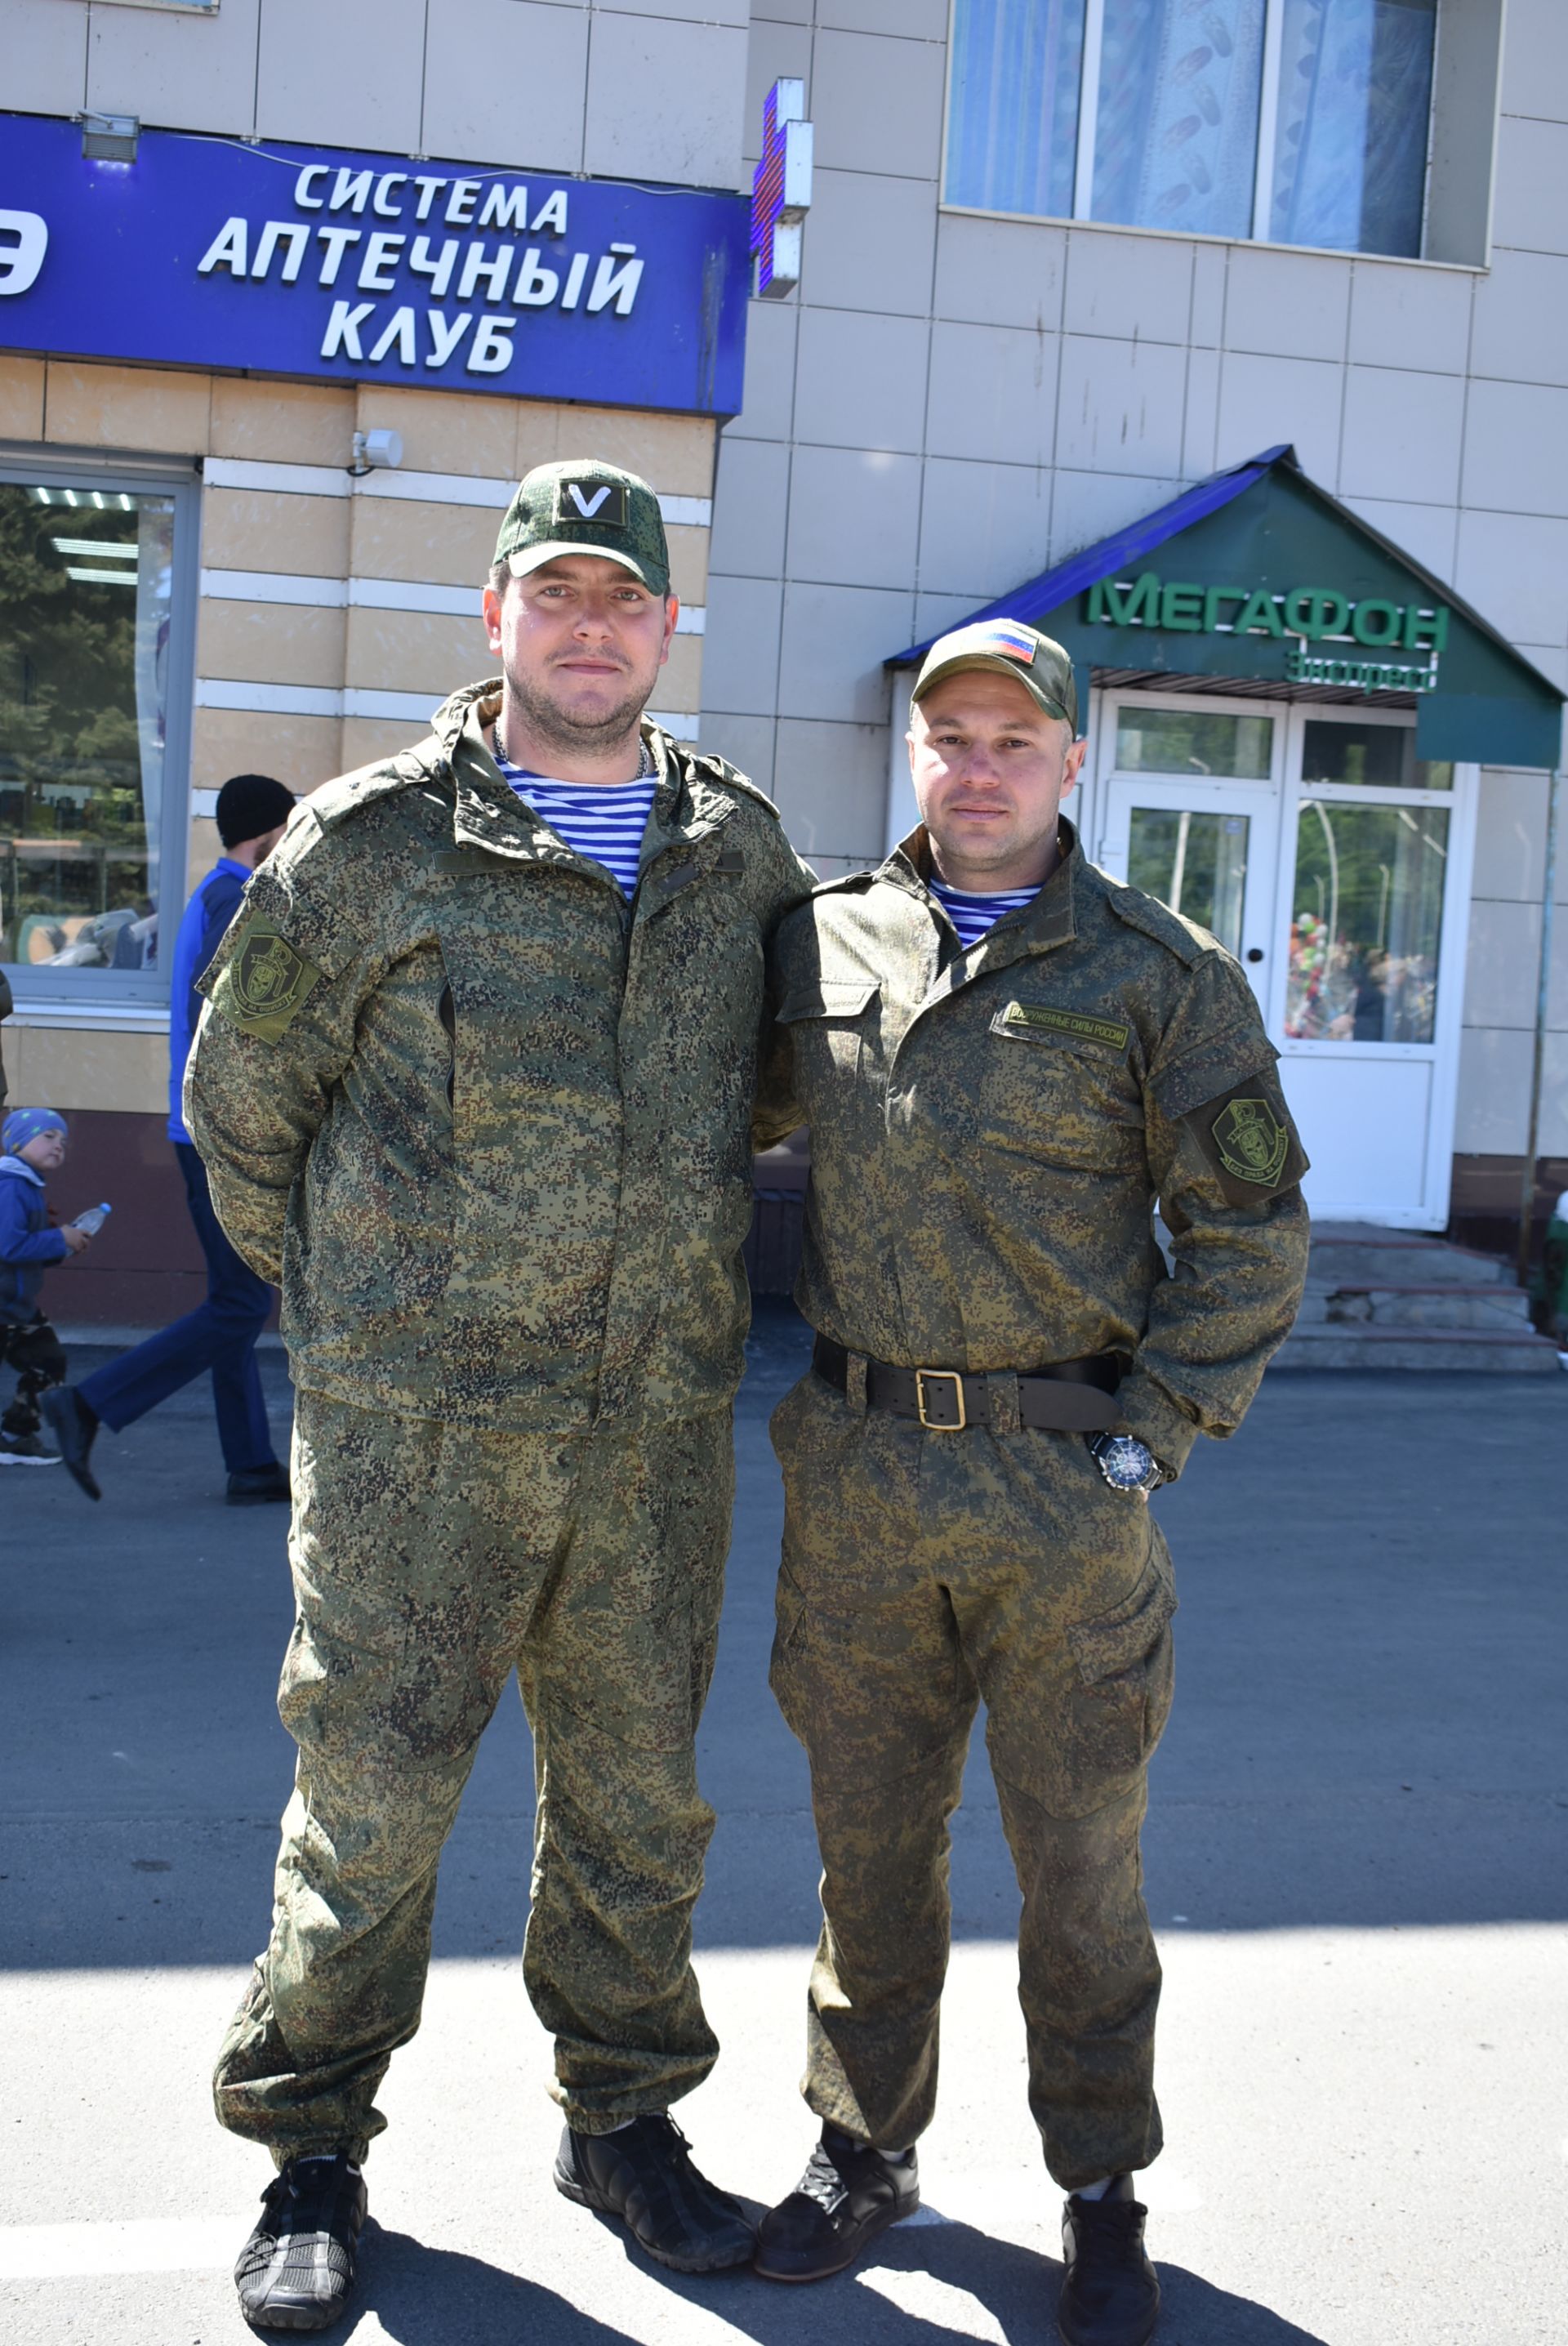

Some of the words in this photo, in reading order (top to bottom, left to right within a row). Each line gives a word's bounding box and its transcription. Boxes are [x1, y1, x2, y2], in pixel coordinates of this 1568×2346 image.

[294, 165, 568, 234] СИСТЕМА
[198, 216, 644, 315] АПТЕЧНЫЙ
[320, 300, 517, 373] КЛУБ
[568, 484, 611, 517] V
[1088, 573, 1449, 652] МЕГАФОН
[1286, 650, 1437, 694] Экспресс
[1011, 1008, 1071, 1028] ВООРУЖЕННЫЕ
[1071, 1019, 1094, 1033] СИЛЫ
[1094, 1024, 1125, 1041] РОССИИ
